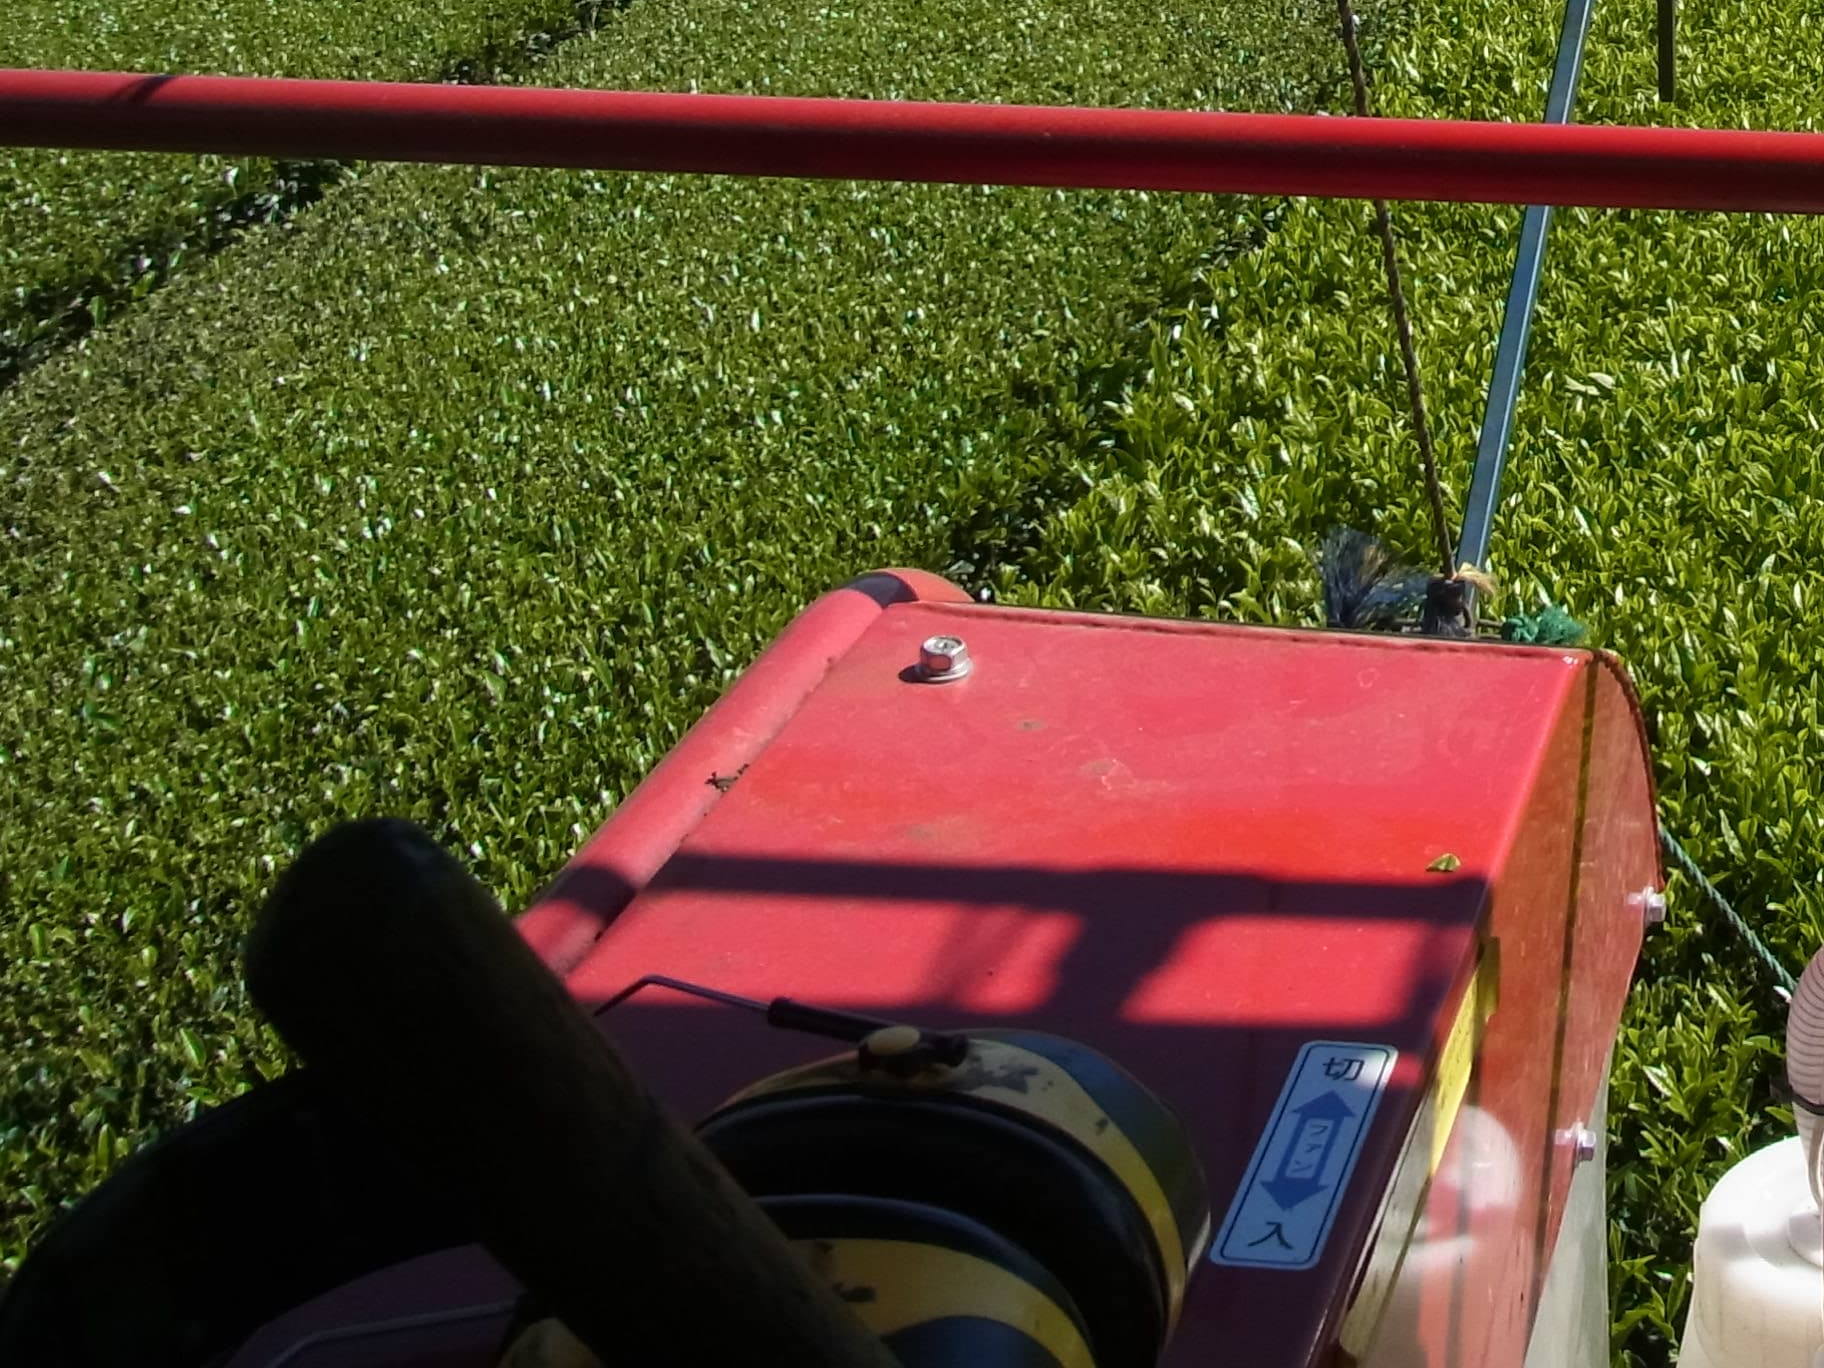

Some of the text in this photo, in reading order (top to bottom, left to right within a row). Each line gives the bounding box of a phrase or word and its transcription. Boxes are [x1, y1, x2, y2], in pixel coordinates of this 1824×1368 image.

[1322, 1057, 1365, 1081] 切
[1291, 1124, 1329, 1173] ファン
[1247, 1222, 1294, 1250] 入
